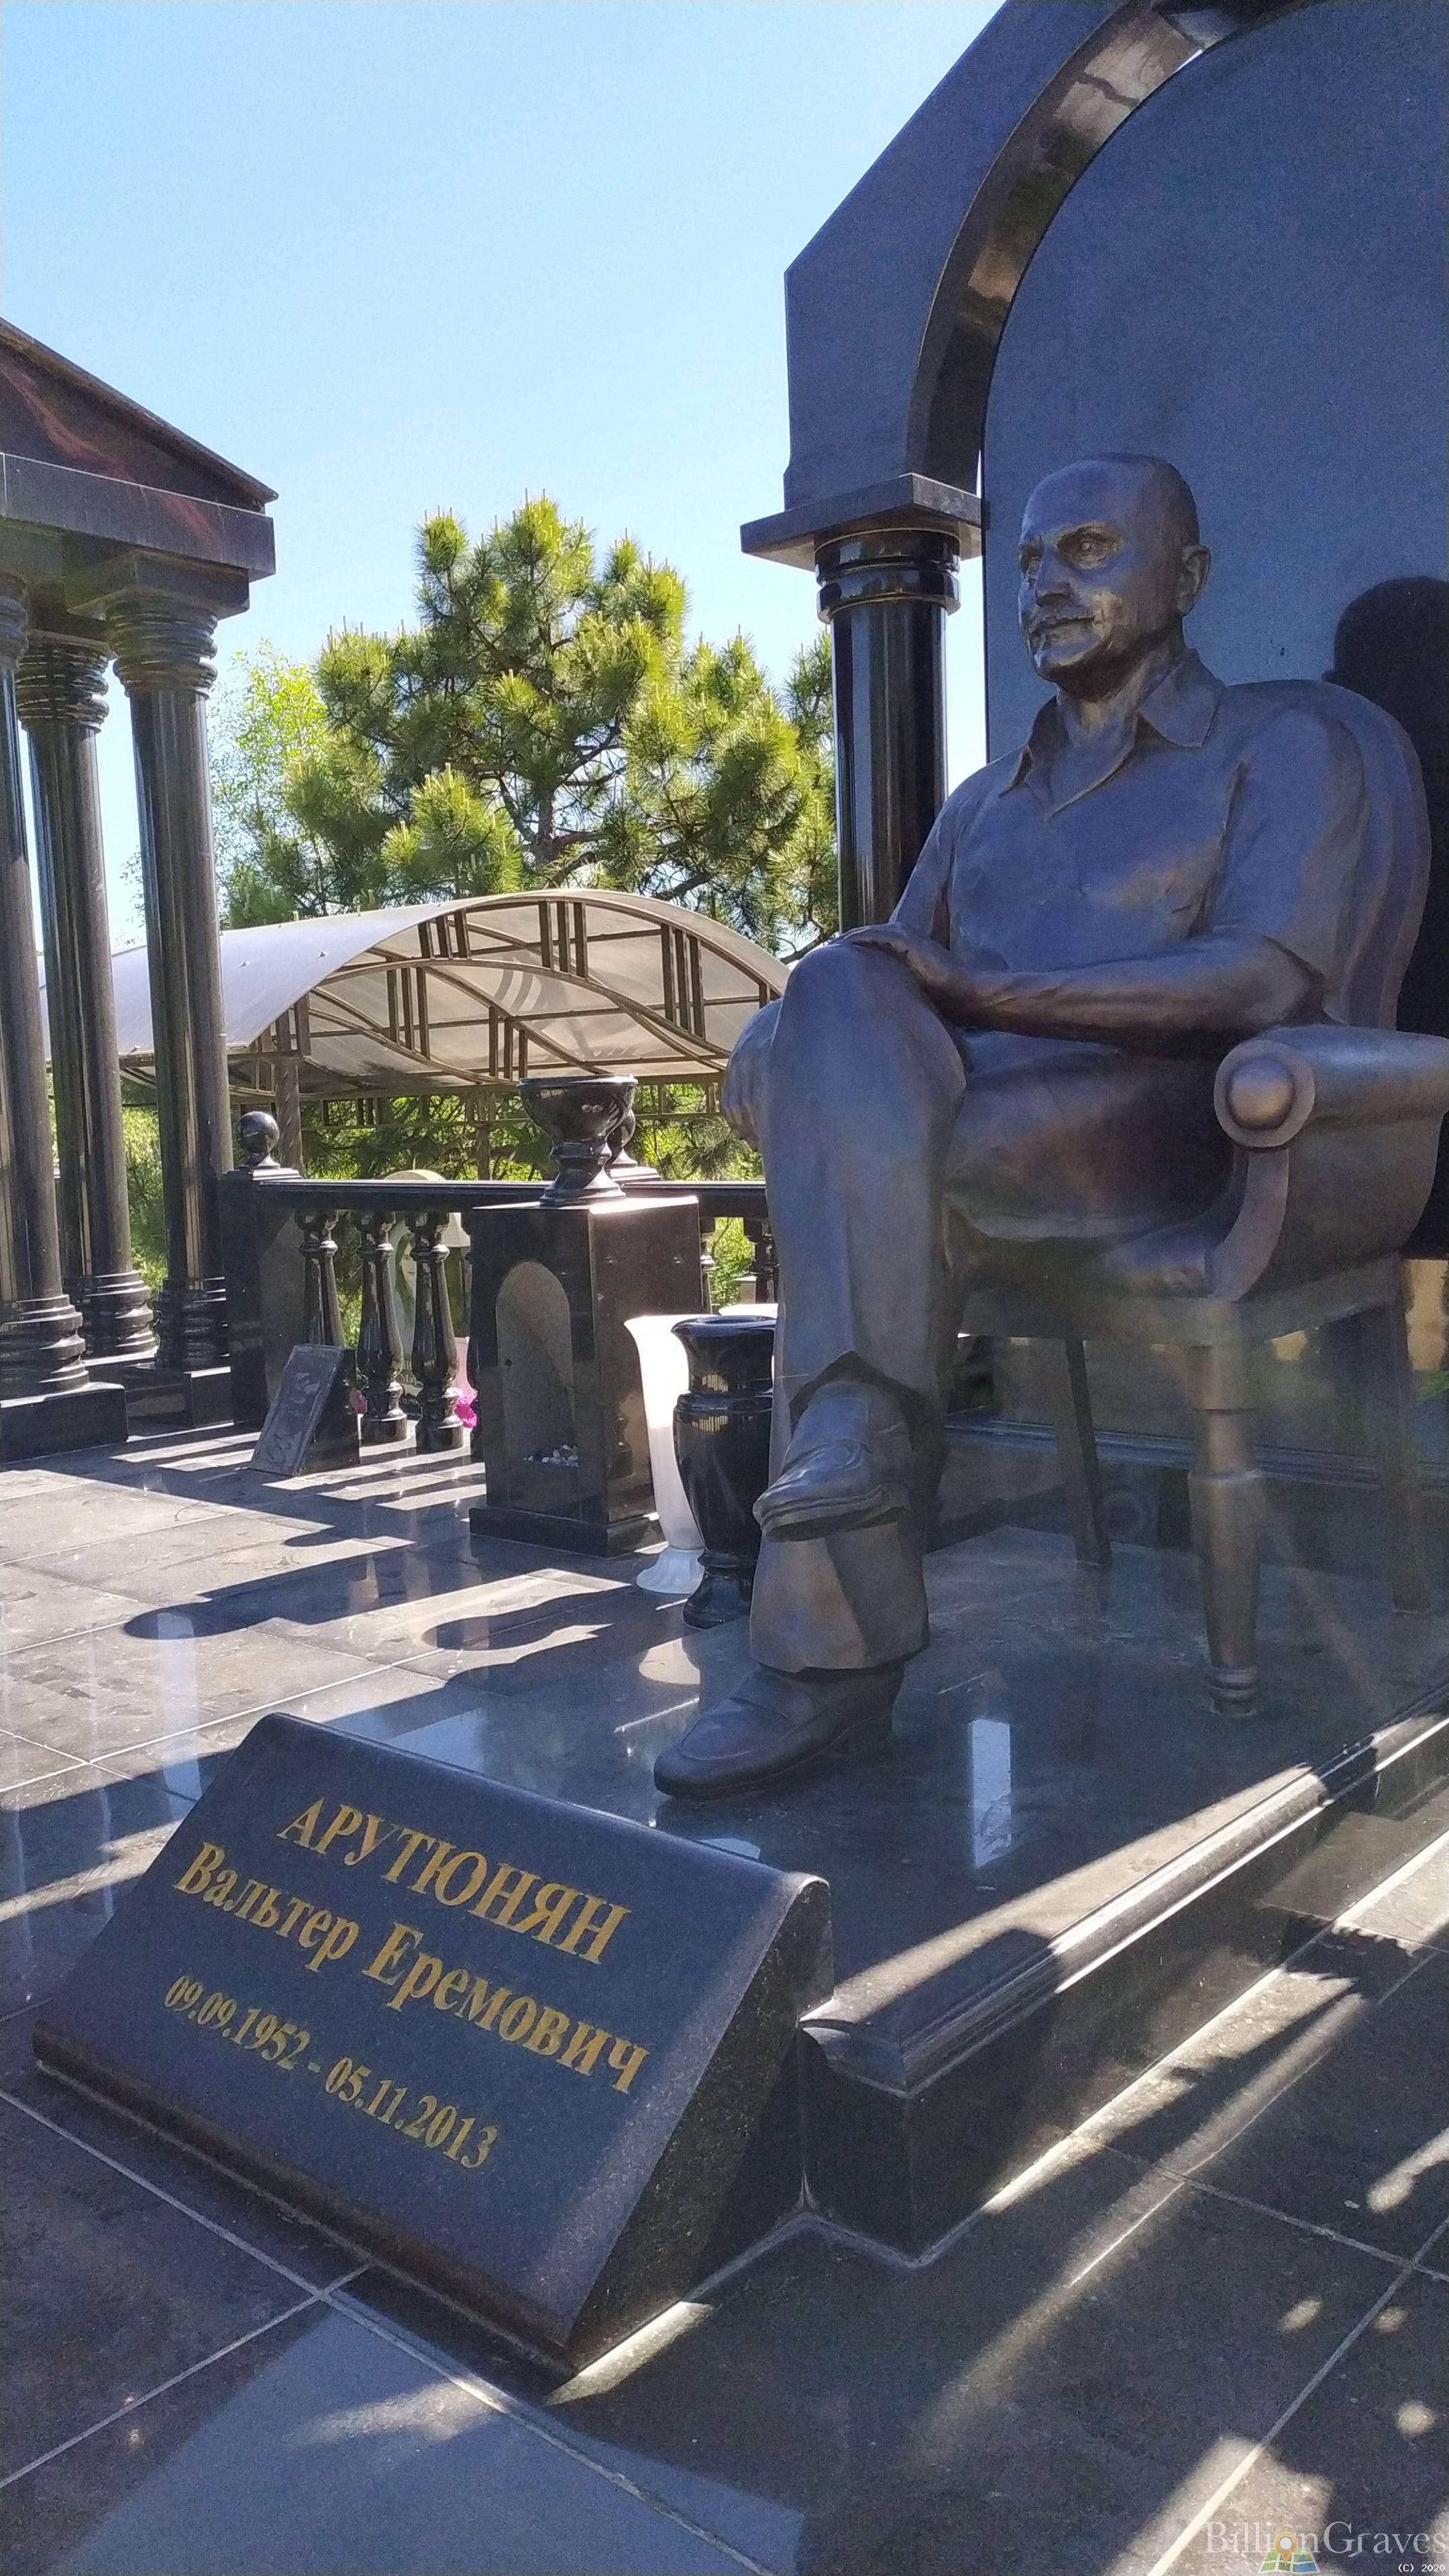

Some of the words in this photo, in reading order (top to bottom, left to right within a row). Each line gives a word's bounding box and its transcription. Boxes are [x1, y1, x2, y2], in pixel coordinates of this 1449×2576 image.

[172, 1842, 360, 1972] Вальтер
[363, 1923, 650, 2094] Еремович
[276, 1796, 631, 1964] АРУТЮНЯН
[164, 1975, 311, 2071] 09.09.1952
[324, 2056, 498, 2169] 05.11.2013
